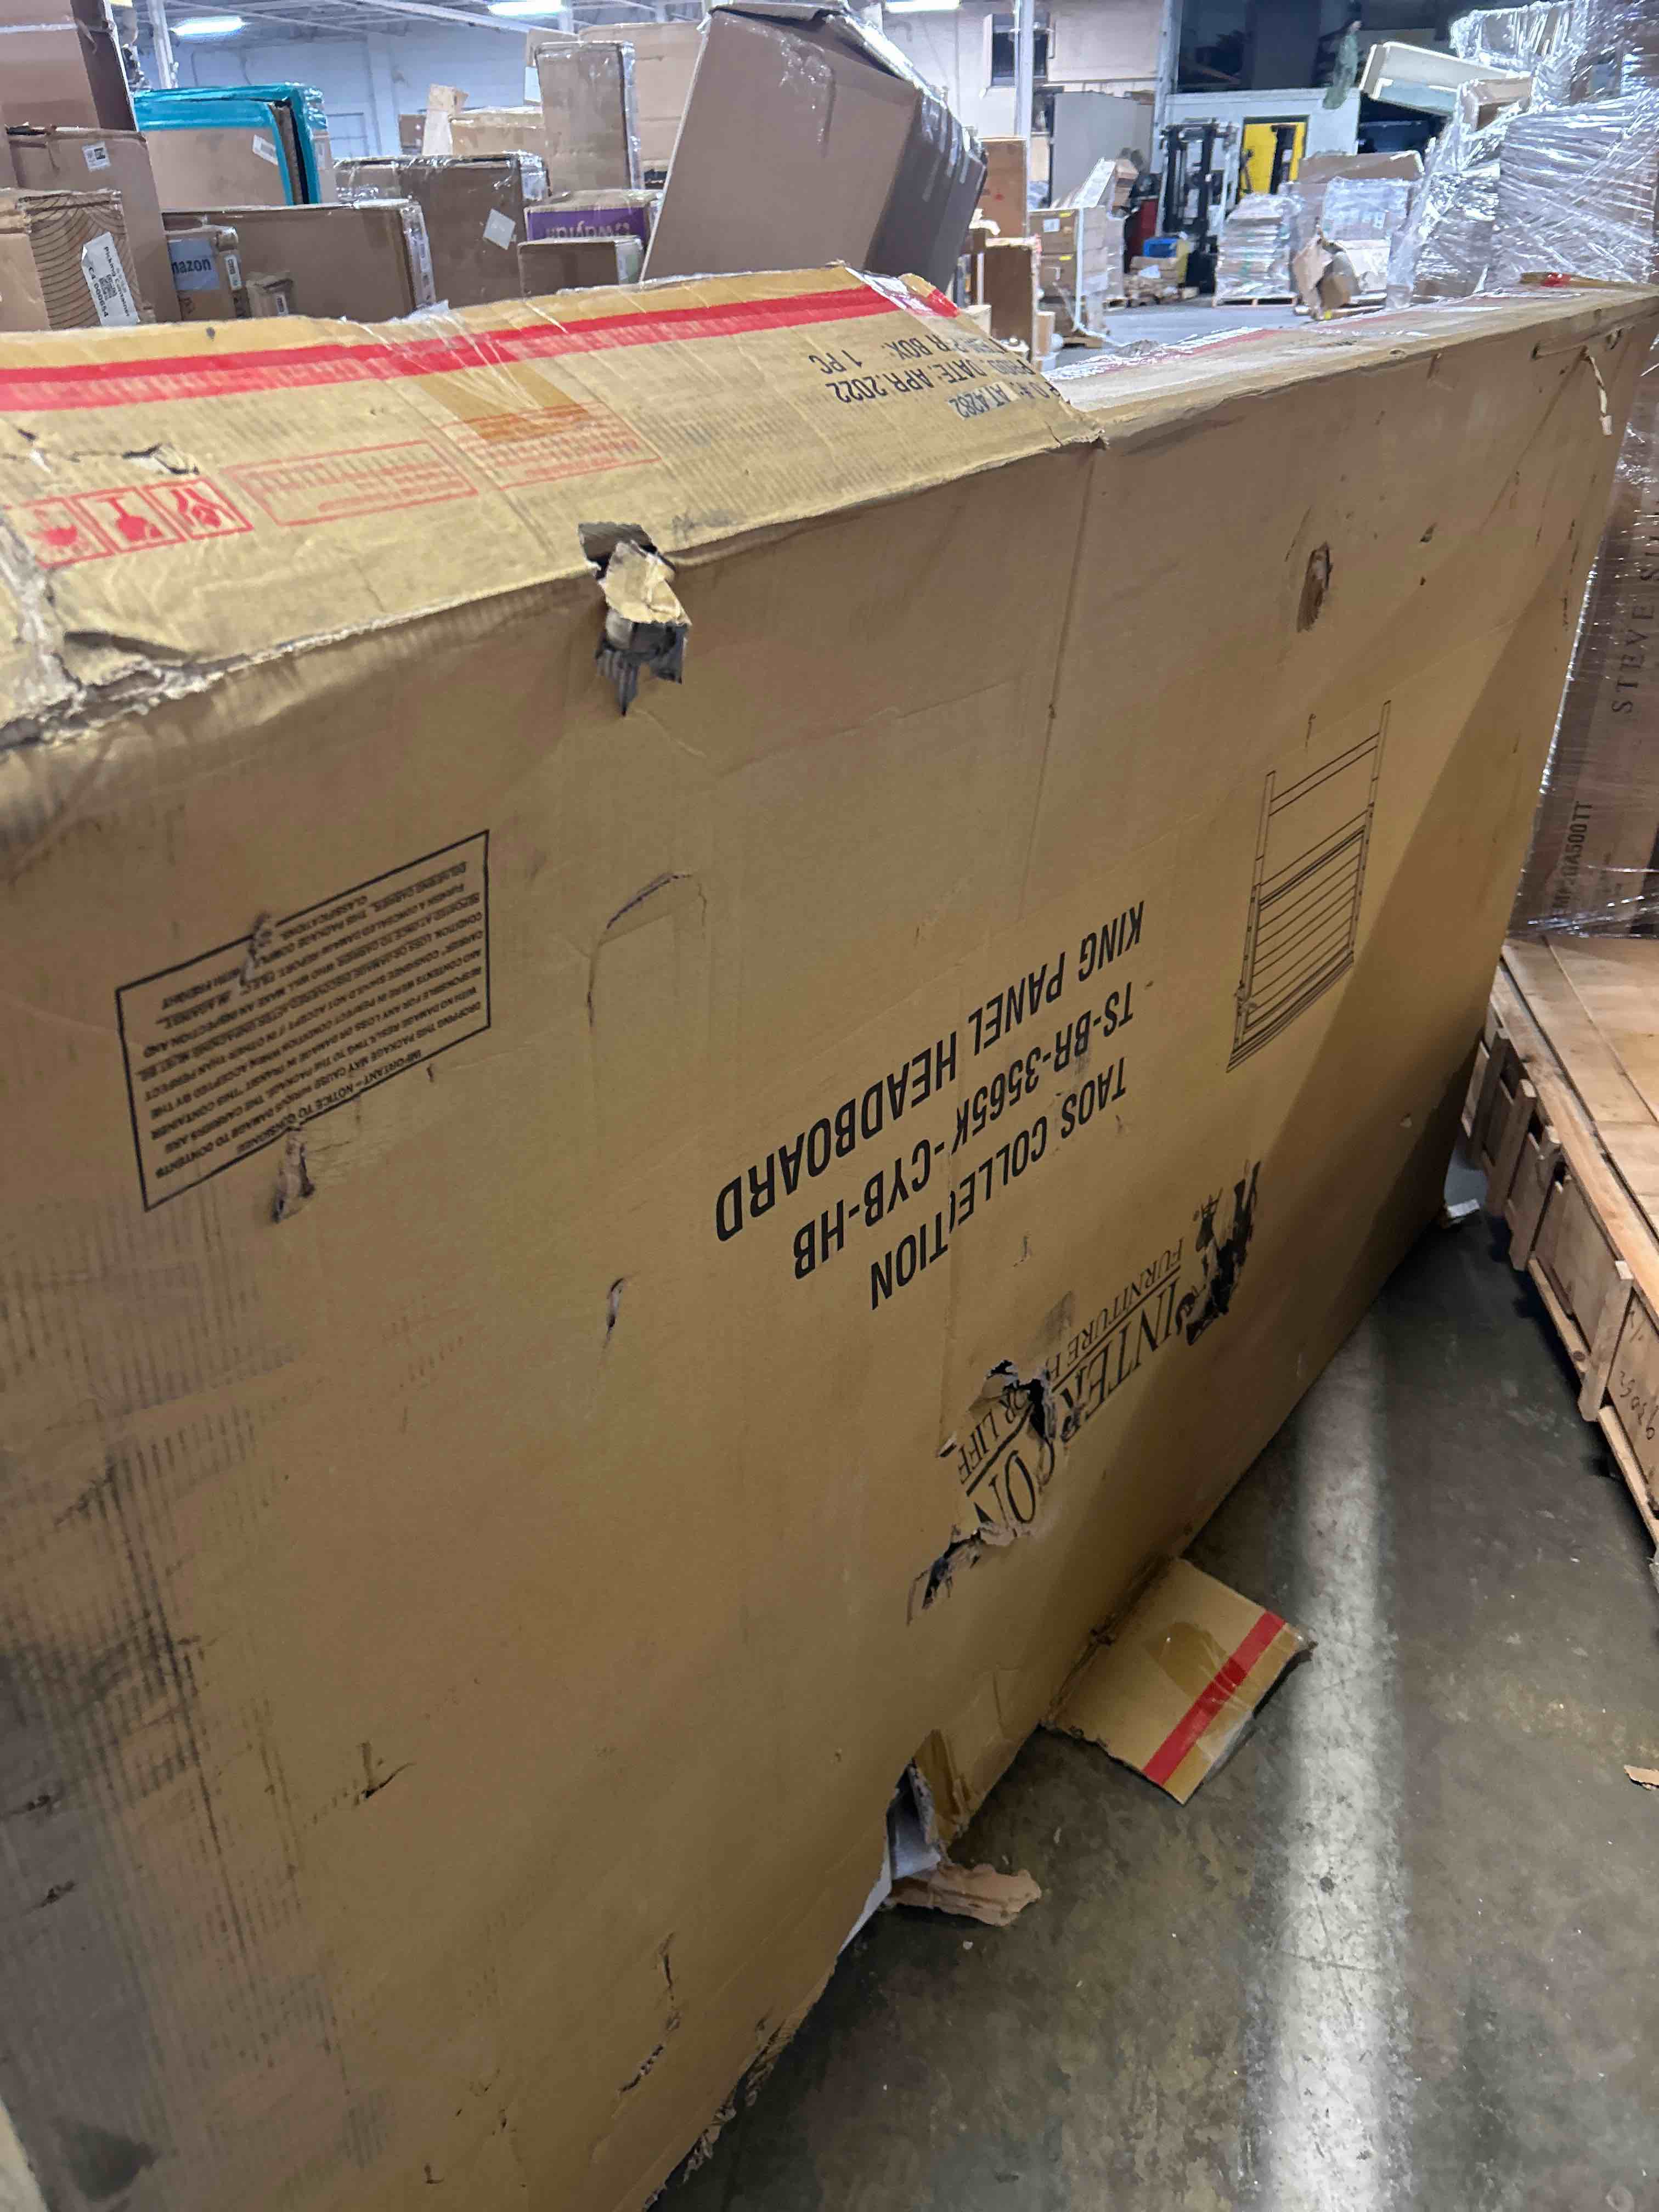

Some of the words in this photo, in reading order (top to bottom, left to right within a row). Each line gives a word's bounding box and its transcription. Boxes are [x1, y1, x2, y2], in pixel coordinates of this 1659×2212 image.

[171, 258, 211, 274] mazon
[808, 352, 847, 374] PC
[840, 349, 862, 369] 1
[928, 358, 988, 384] DATE:
[1078, 901, 1144, 981] KING
[967, 952, 1065, 1056] PANEL
[297, 1102, 313, 1120] TO
[315, 1082, 353, 1111] NOTICE
[1060, 1057, 1126, 1139] TAOS
[715, 1031, 957, 1242] HEADBOARD
[1067, 1237, 1183, 1367] FURNITURE
[957, 1410, 1000, 1484] LIFE
